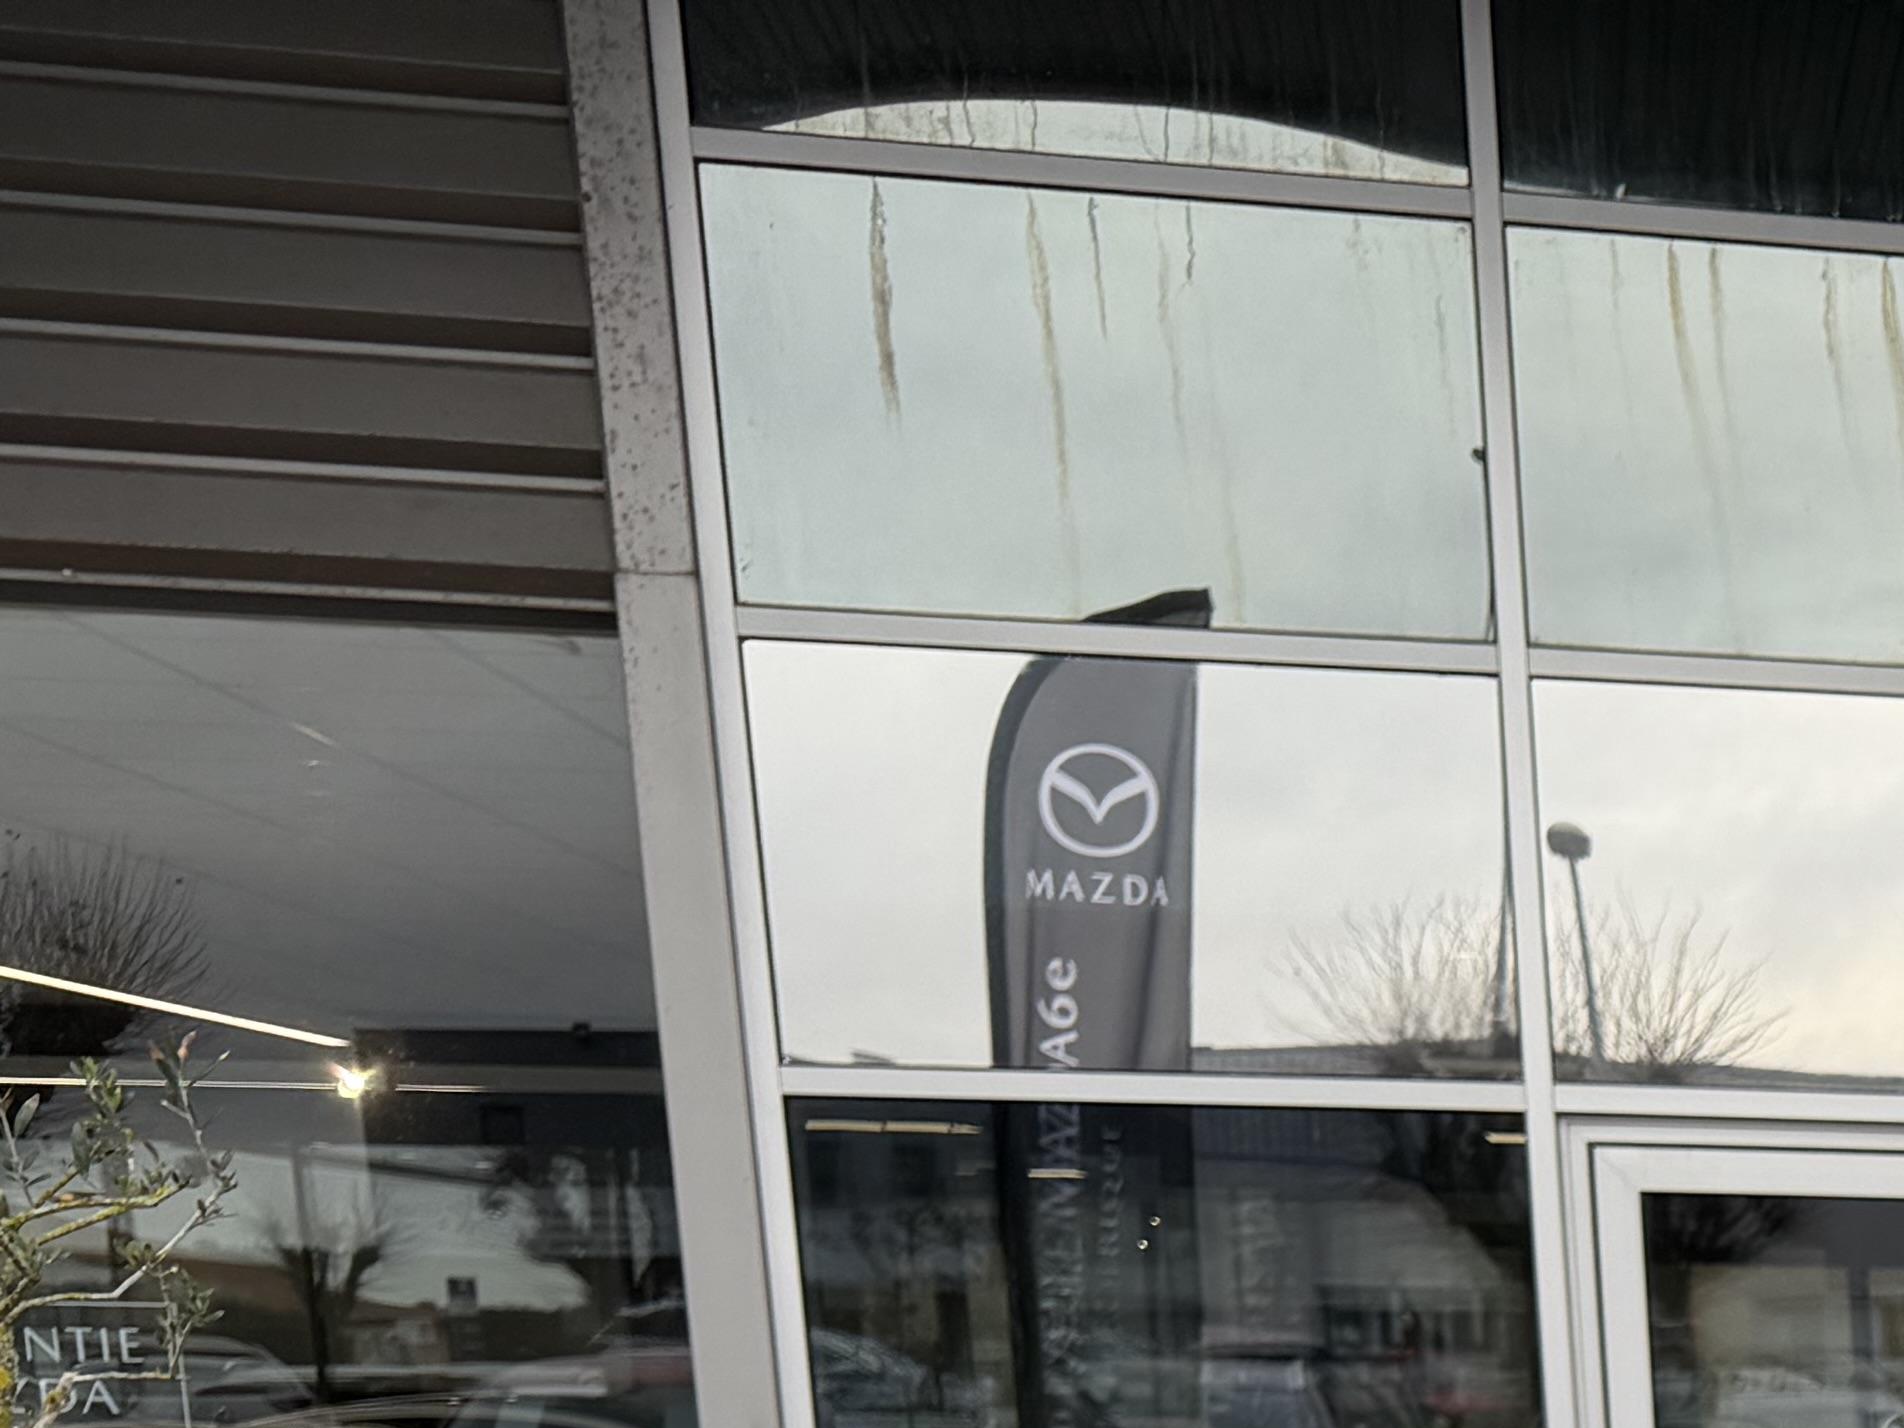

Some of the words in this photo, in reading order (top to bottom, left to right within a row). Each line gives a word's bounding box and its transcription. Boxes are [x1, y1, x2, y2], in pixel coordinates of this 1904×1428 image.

[1024, 869, 1170, 908] MAZDA
[22, 1324, 145, 1365] NTIE
[10, 1376, 121, 1416] ZDA
